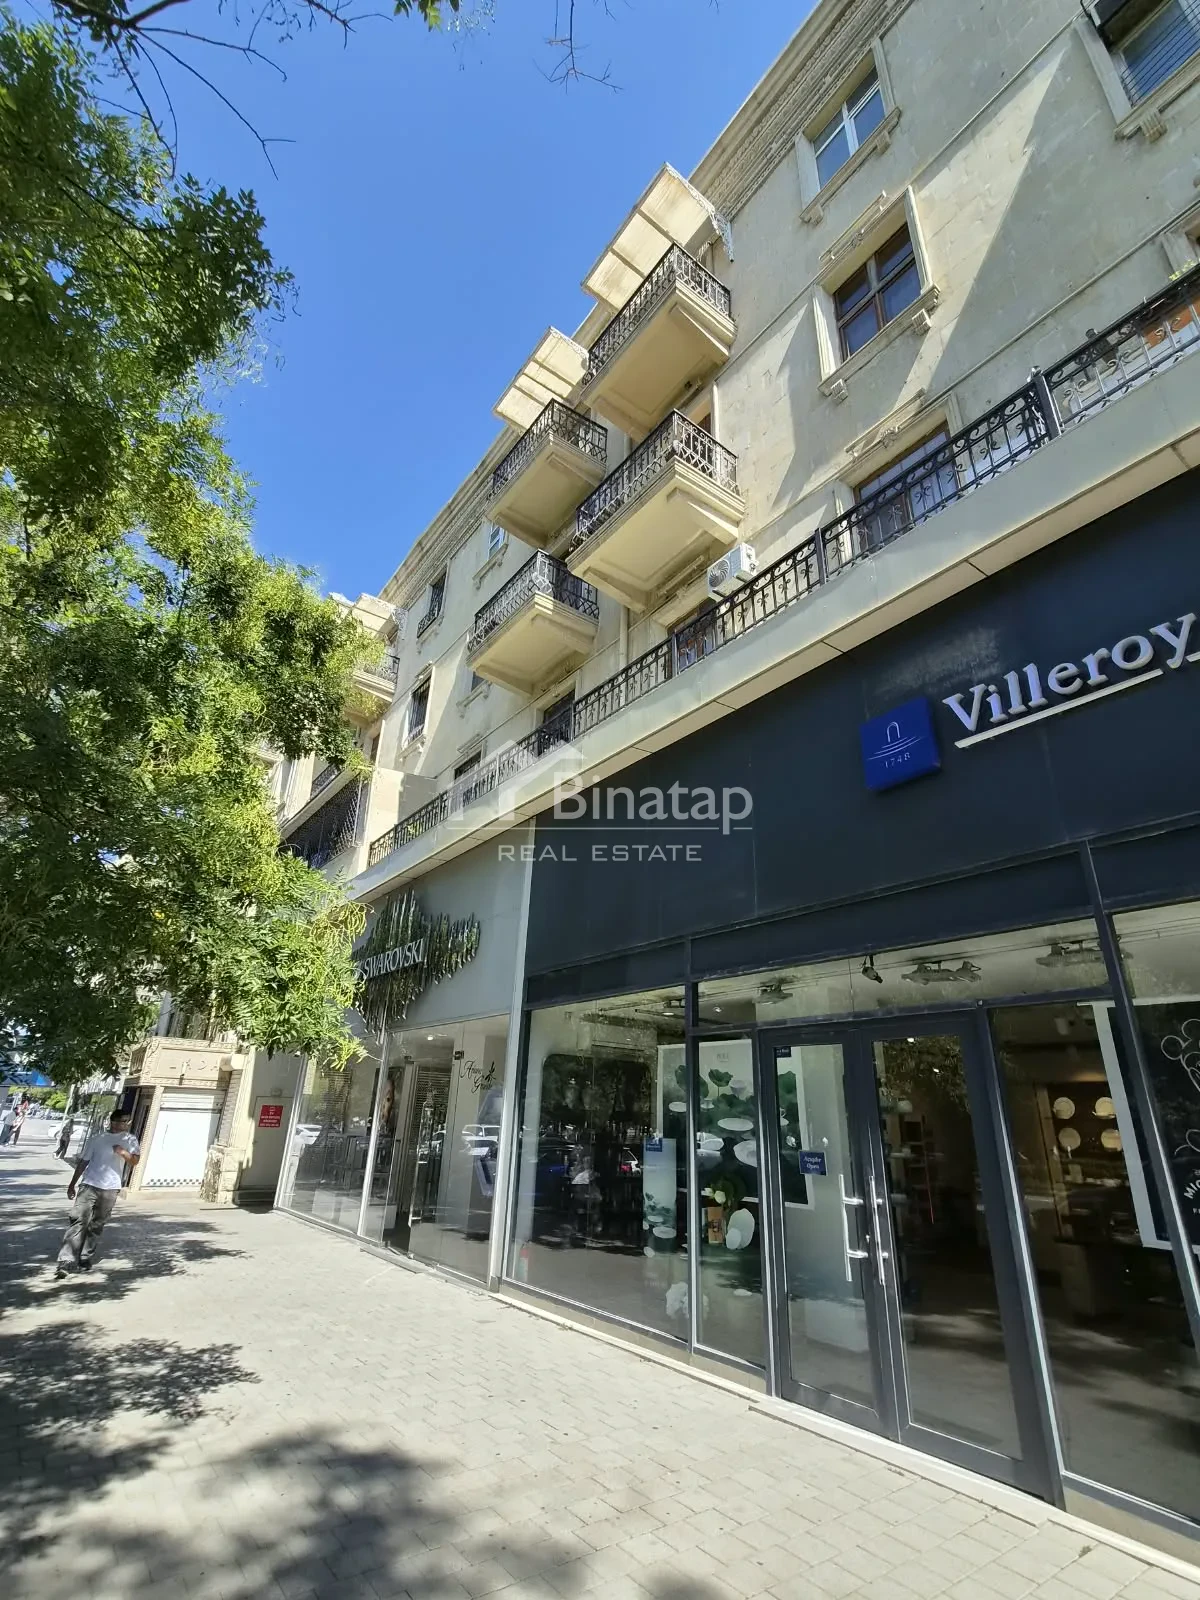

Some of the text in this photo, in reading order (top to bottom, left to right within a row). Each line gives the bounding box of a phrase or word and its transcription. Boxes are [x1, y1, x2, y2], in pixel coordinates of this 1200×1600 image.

[942, 613, 1197, 731] Villeroy
[884, 752, 911, 769] 1748
[364, 938, 424, 978] SWAROVSKI
